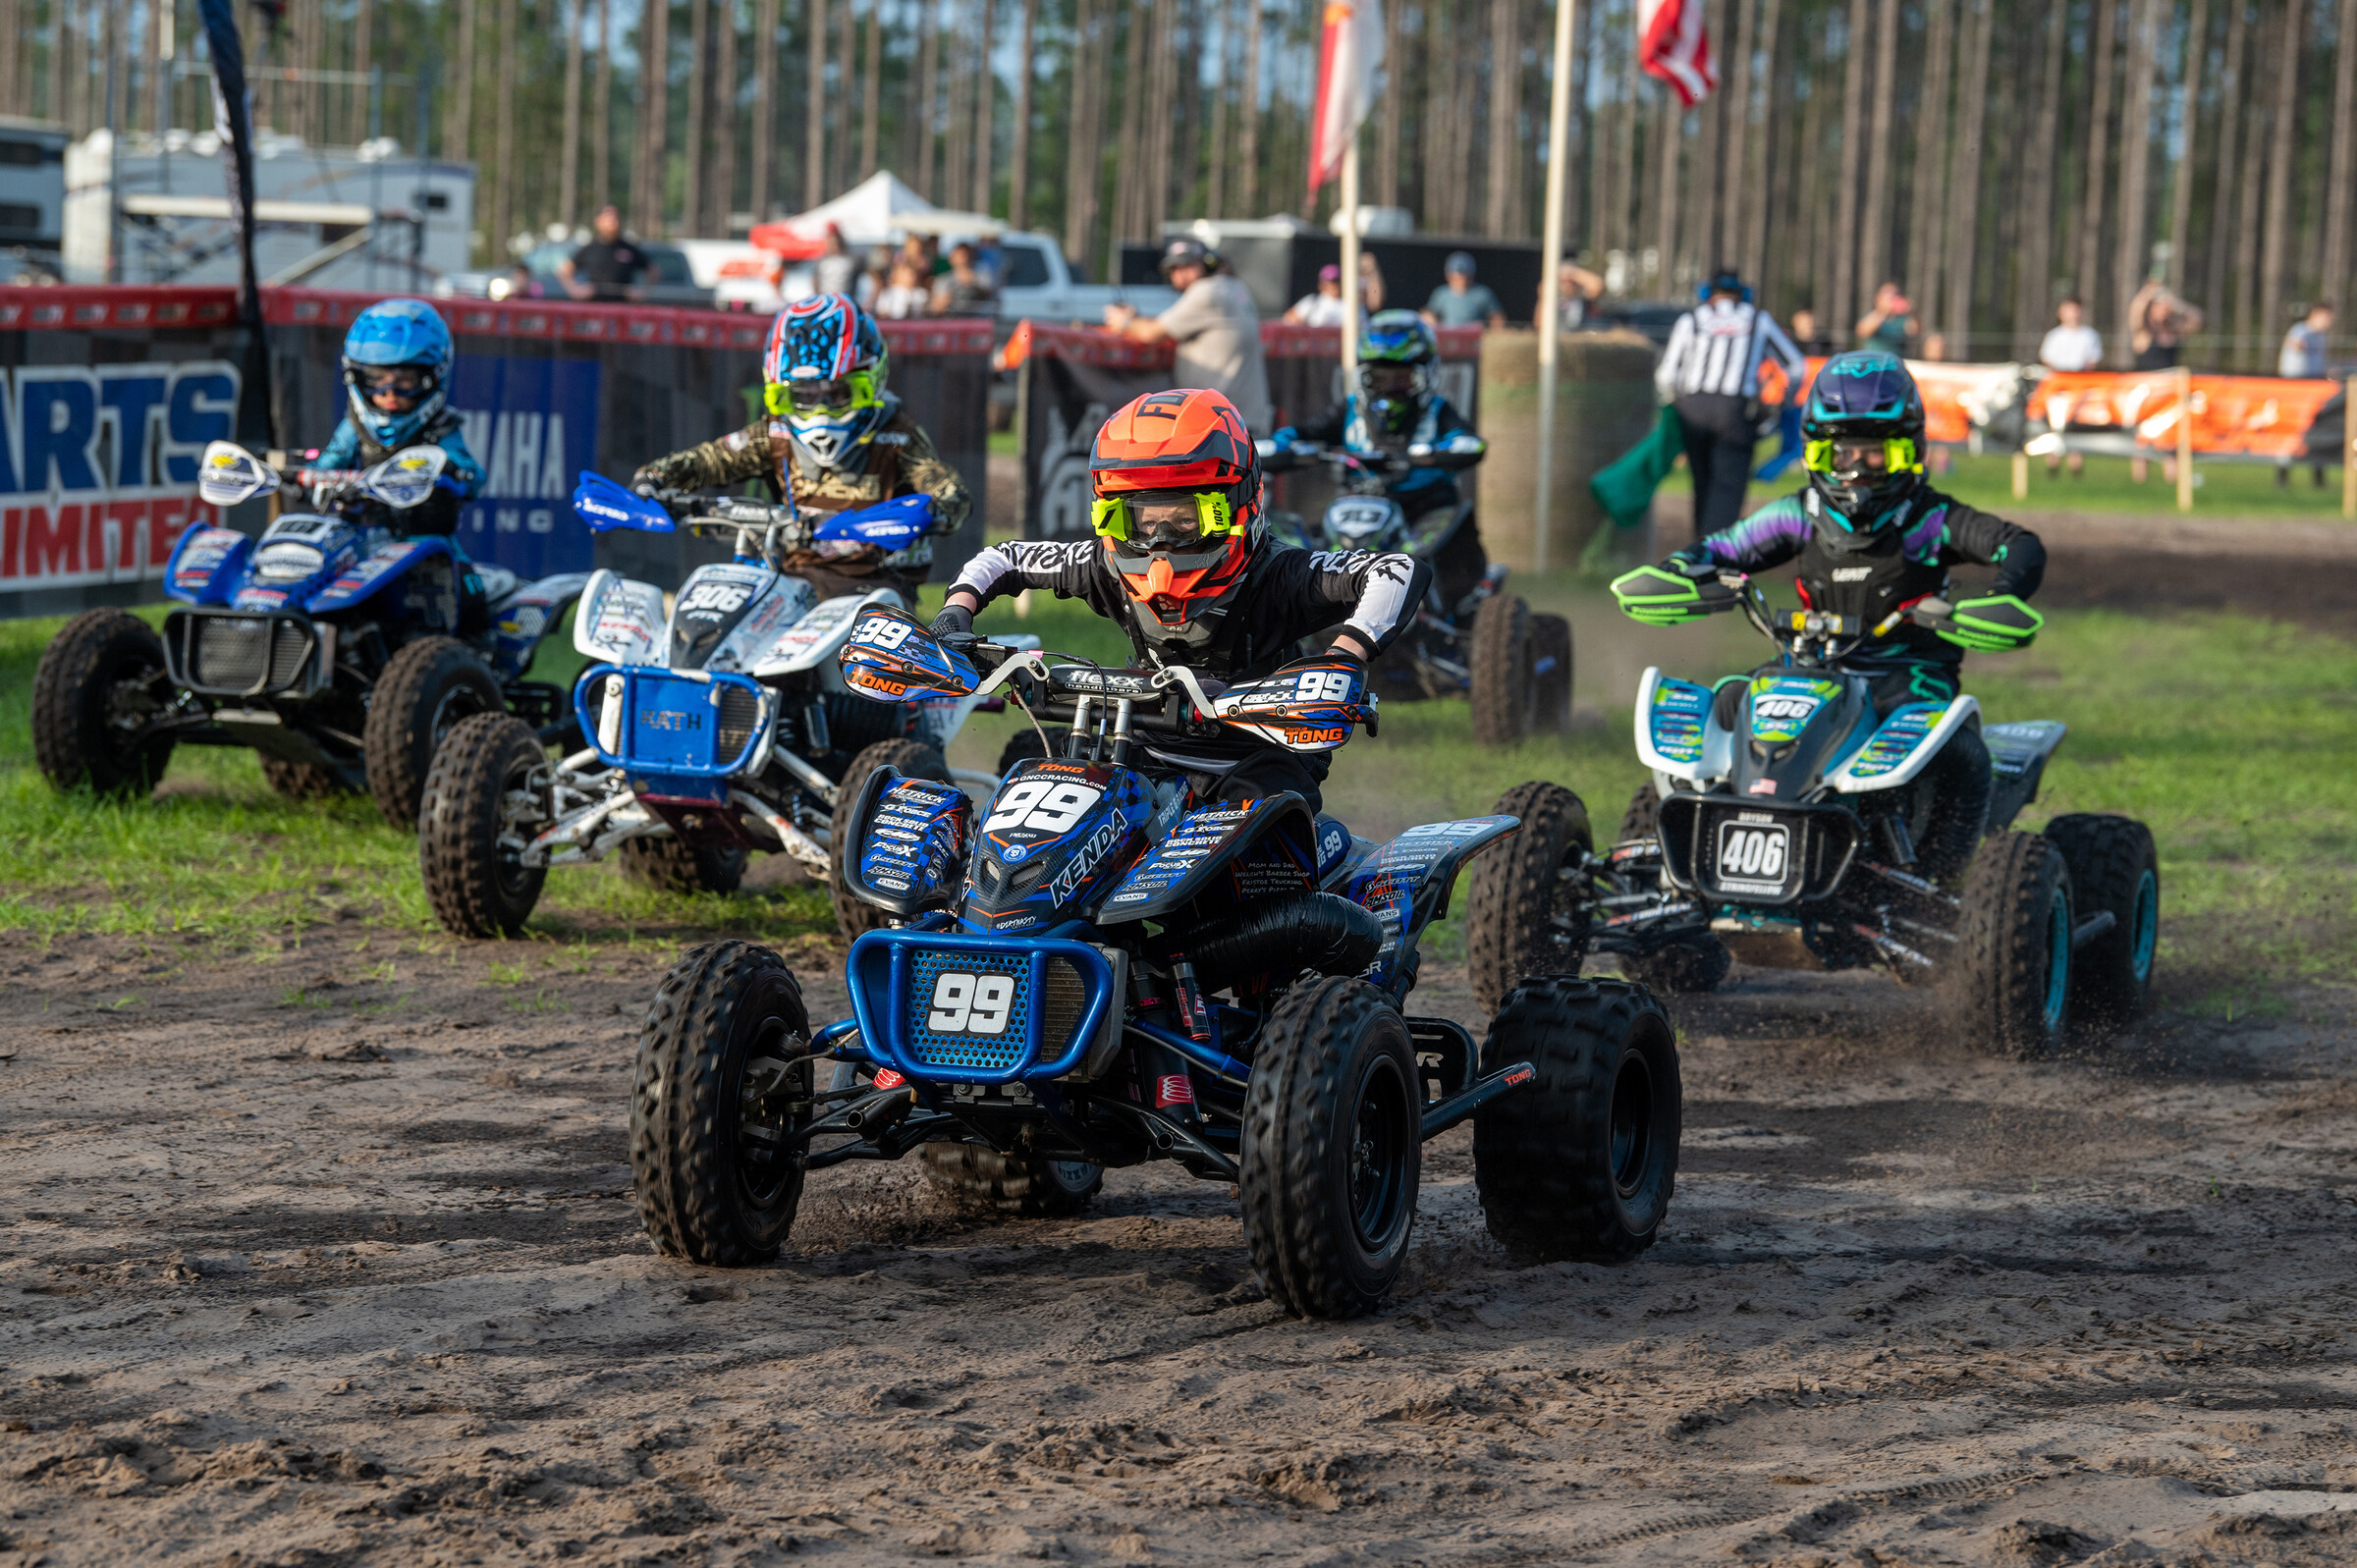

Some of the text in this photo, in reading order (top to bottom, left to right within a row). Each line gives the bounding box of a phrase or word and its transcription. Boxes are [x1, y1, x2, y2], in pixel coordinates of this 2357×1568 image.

[1211, 502, 1224, 527] 100%
[679, 584, 753, 613] 306
[855, 617, 913, 650] 99
[851, 670, 907, 696] TONG
[1295, 672, 1351, 702] 99
[1757, 701, 1812, 719] 406
[1285, 728, 1343, 744] TONG
[1037, 764, 1085, 774] TONG
[888, 787, 947, 803] HETRICK
[982, 781, 1101, 834] 99
[1186, 809, 1251, 822] HETRICK
[1401, 823, 1494, 838] 99
[1323, 830, 1343, 859] 99
[1722, 830, 1785, 876] 406
[1050, 807, 1128, 909] KENDA
[879, 879, 907, 890] EVANS
[1363, 889, 1405, 907] AMSOIL
[1375, 910, 1398, 919] VANS
[928, 973, 1014, 1033] 99
[1505, 1068, 1532, 1086] TONG
